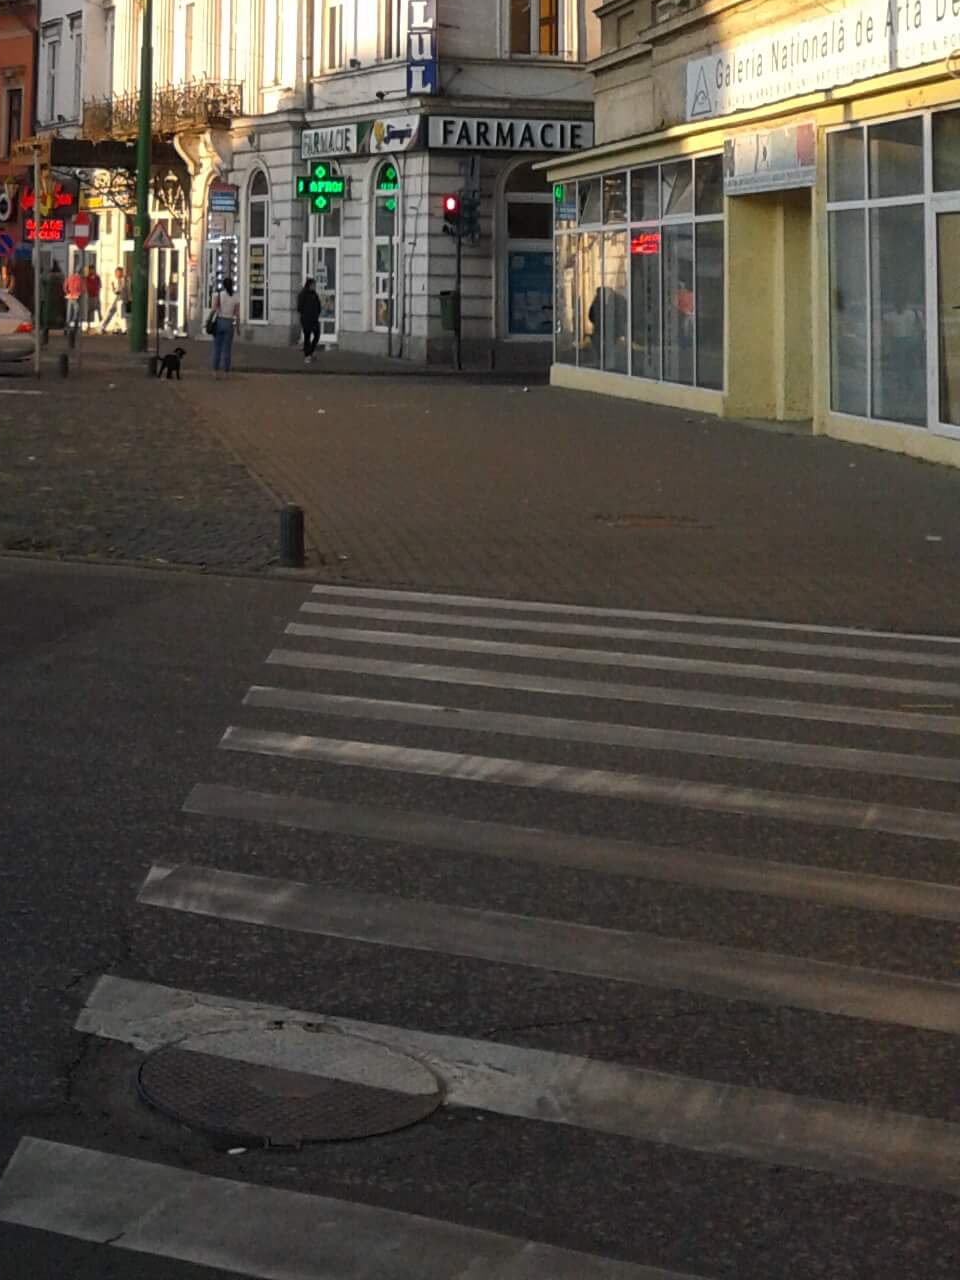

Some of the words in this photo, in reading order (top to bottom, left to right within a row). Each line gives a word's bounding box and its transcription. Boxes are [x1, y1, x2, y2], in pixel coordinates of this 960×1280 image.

[715, 49, 763, 90] Galeria
[855, 9, 874, 47] de
[442, 119, 583, 149] FARMACIE
